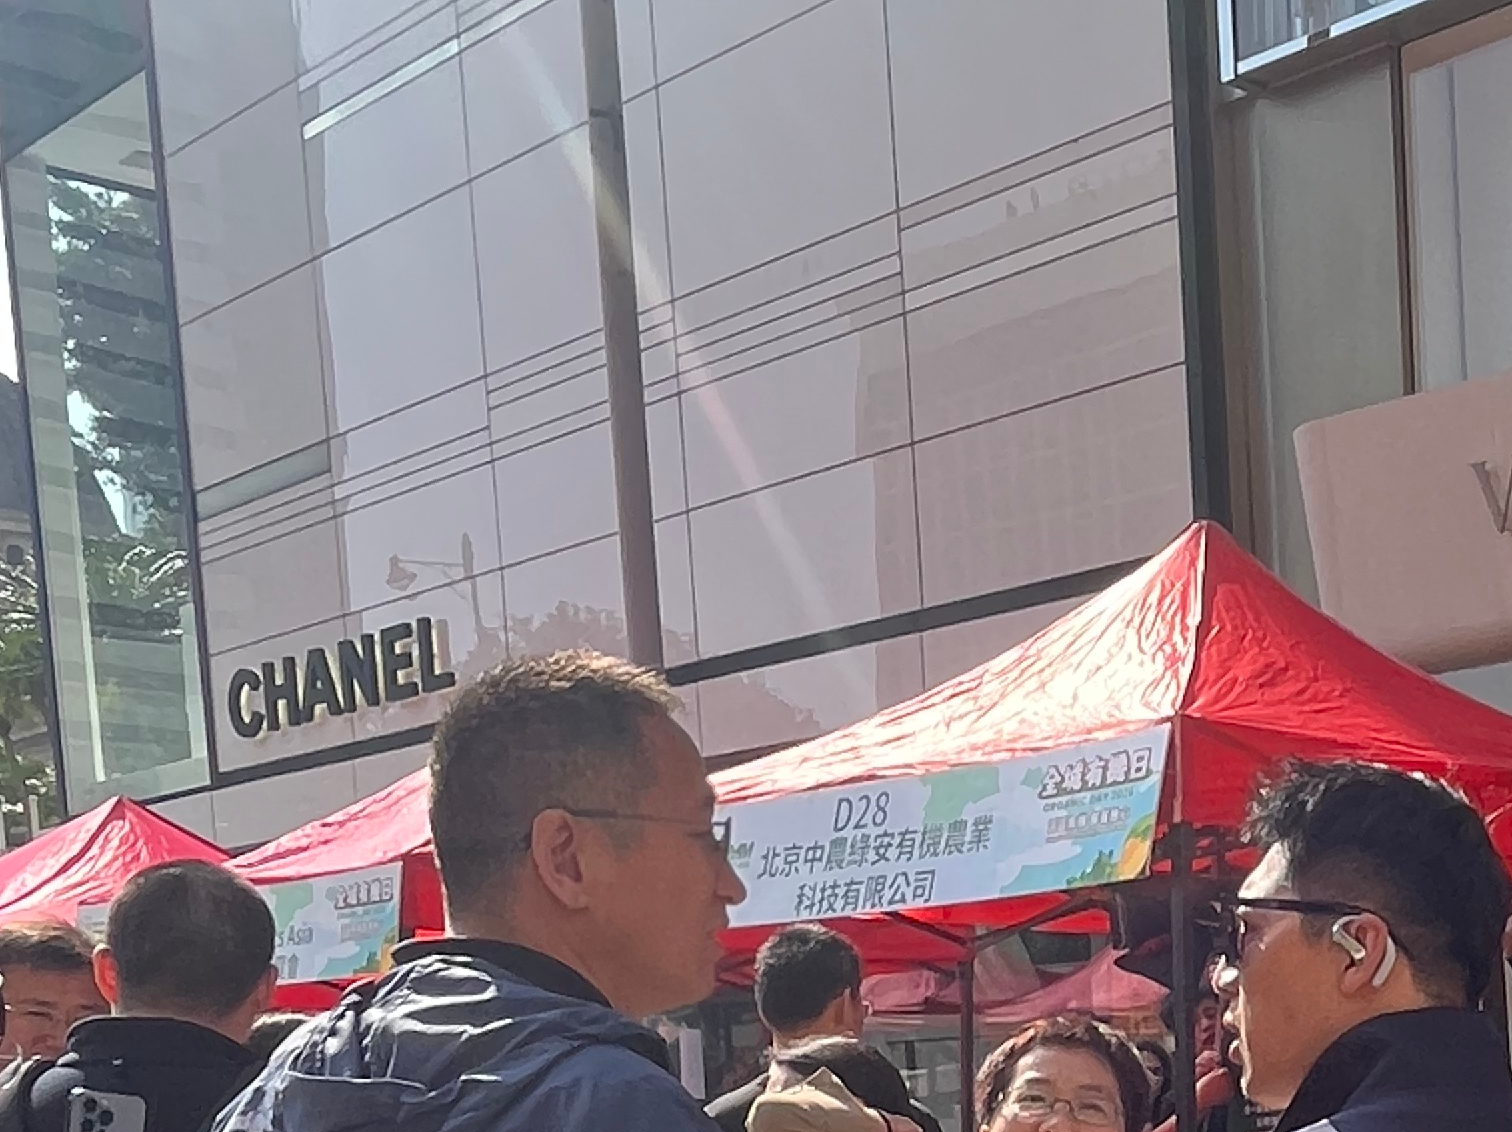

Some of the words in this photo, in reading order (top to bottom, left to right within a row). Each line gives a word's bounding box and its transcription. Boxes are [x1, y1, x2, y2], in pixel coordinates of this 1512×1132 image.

[228, 616, 456, 738] CHANEL
[833, 791, 890, 832] D28
[757, 815, 994, 880] 北京中農綠安有機農業
[794, 868, 936, 917] 科技有限公司
